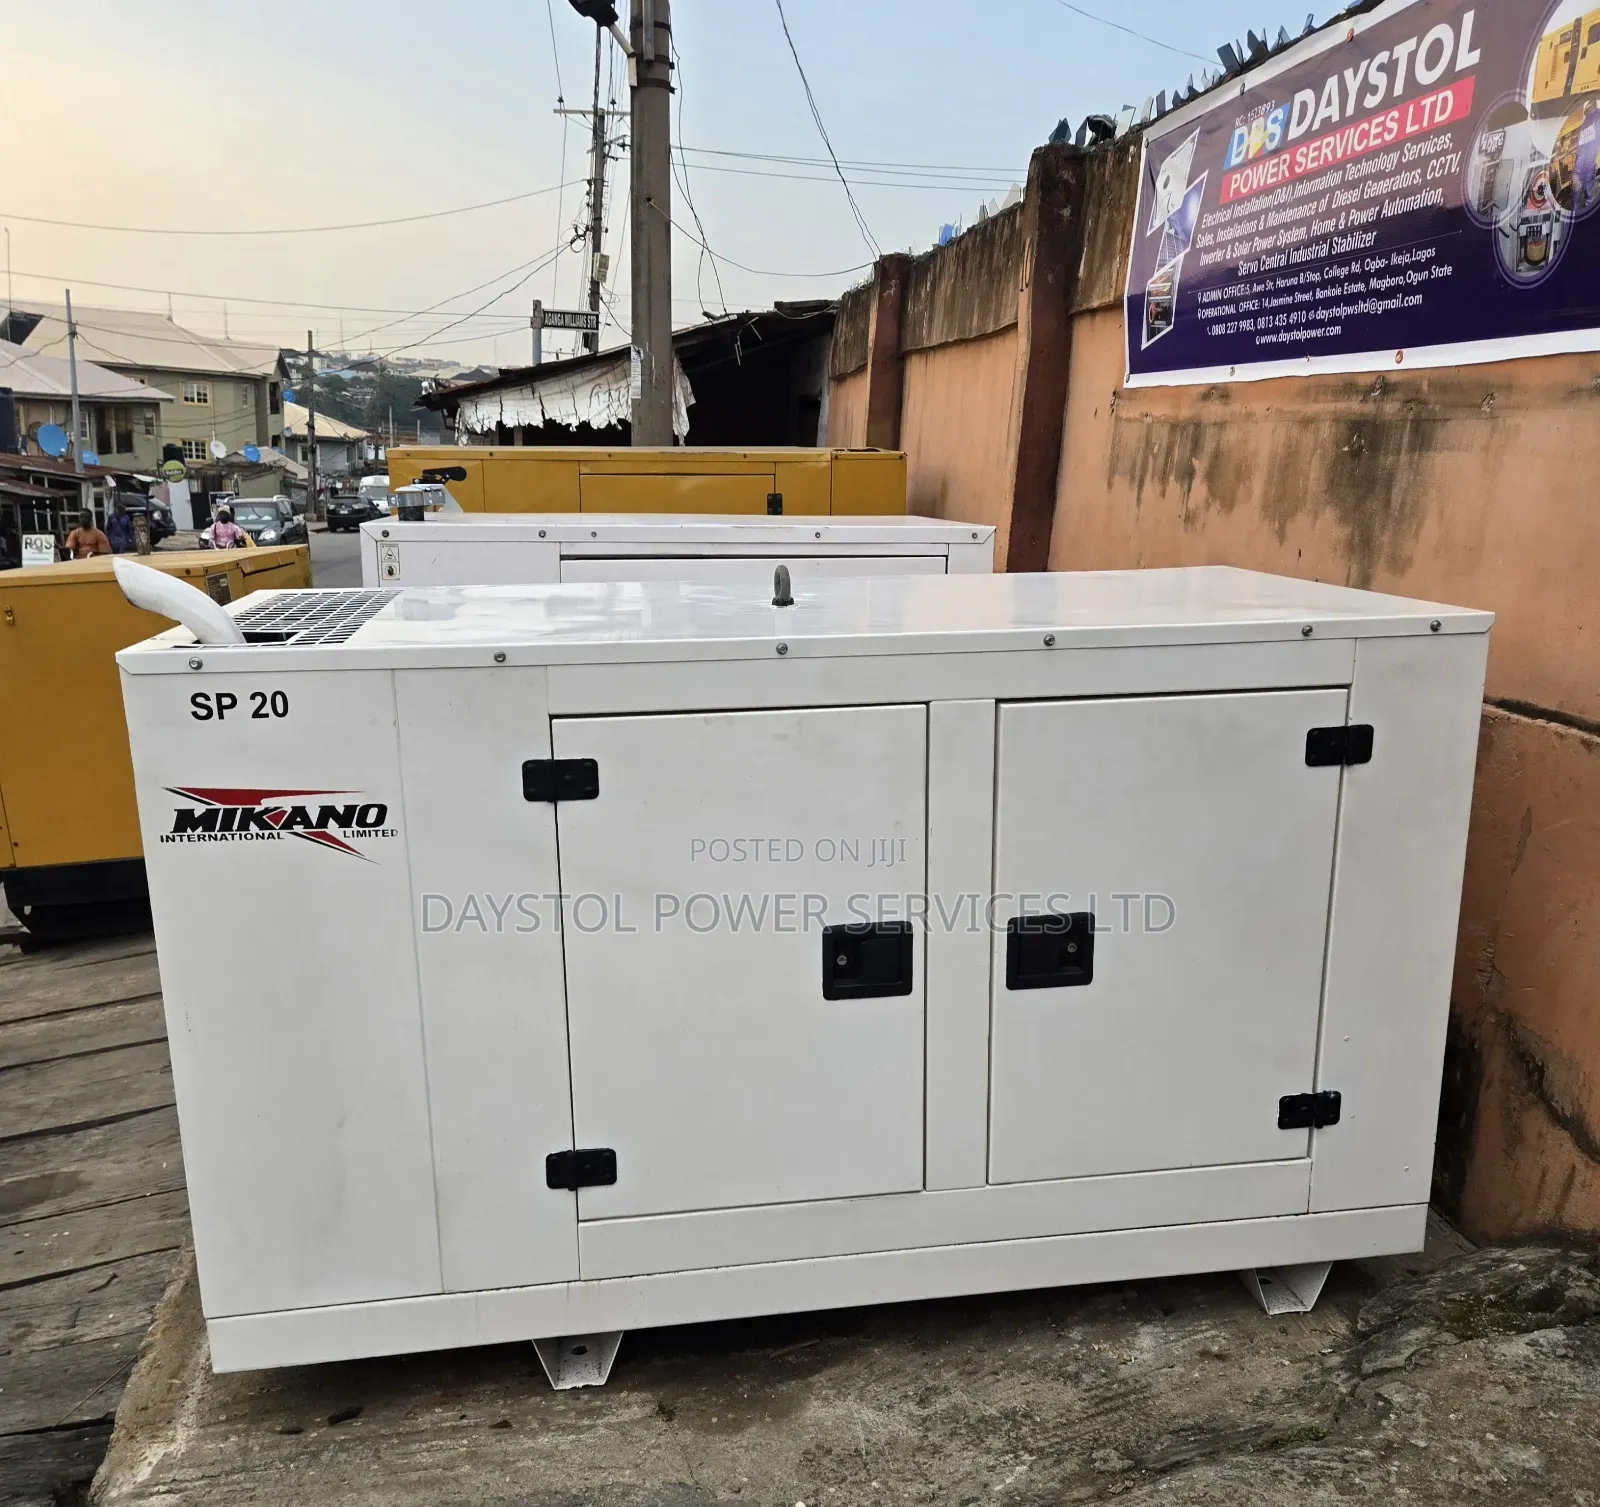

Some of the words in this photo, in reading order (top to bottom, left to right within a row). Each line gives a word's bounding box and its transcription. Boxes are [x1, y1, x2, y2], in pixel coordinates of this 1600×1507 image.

[1230, 108, 1284, 167] DPS
[1287, 9, 1482, 141] DAYSTOL
[1229, 153, 1290, 198] POWER
[1294, 110, 1399, 174] SERVICES
[1405, 90, 1454, 134] LTD
[1196, 231, 1215, 249] Sales,
[1216, 217, 1258, 243] Installations
[1259, 214, 1265, 231] &
[1266, 203, 1317, 228] Maintenance
[1318, 193, 1330, 213] of
[1331, 182, 1363, 209] Diesel
[1364, 168, 1422, 200] Generators,
[1427, 153, 1461, 180] CCTV,
[1201, 205, 1233, 229] Electrical
[1345, 150, 1401, 182] Technology
[1402, 132, 1453, 163] Services,
[1199, 247, 1226, 267] Inverter
[1226, 244, 1232, 260] &
[1232, 239, 1252, 258] Solar
[1252, 233, 1277, 253] Power
[1277, 226, 1308, 248] System,
[1311, 216, 1337, 237] Home
[1338, 211, 1346, 230] &
[1347, 206, 1380, 228] Power
[1380, 187, 1444, 218] Automation,
[1238, 259, 1259, 277] Servo
[1260, 249, 1288, 272] Central
[1289, 238, 1330, 265] Industrial
[1331, 230, 1377, 255] Stabilizer
[1201, 303, 1237, 319] OPERATIONAL
[1238, 299, 1260, 313] OFFICE:
[1294, 290, 1314, 304] Street,
[1315, 283, 1342, 300] Bankole
[1343, 281, 1367, 295] Estate,
[1430, 264, 1453, 279] State
[1202, 288, 1222, 304] ADMIN
[1252, 282, 1265, 294] Awe
[1276, 276, 1298, 289] Haruna
[1299, 270, 1322, 285] B/Stop,
[1323, 265, 1349, 280] College
[1350, 259, 1362, 274] Rd,
[1364, 256, 1388, 273] Ogba-
[544, 313, 564, 326] AGANGA
[565, 314, 586, 328] WILLIAMS
[587, 316, 597, 328] STR
[1211, 323, 1226, 336] 0808
[1226, 321, 1238, 334] 227
[1256, 315, 1273, 330] 0813
[1274, 313, 1288, 327] 435
[1289, 310, 1307, 325] 4910
[1315, 292, 1423, 322] daystolpwsltd@gmail.com
[1260, 325, 1342, 344] www.daystolpower.com
[190, 692, 238, 721] SP
[249, 690, 289, 719] 20
[159, 831, 286, 844] INTERNATIONAL
[343, 829, 399, 839] LIMITED
[170, 804, 388, 833] MIKANO
